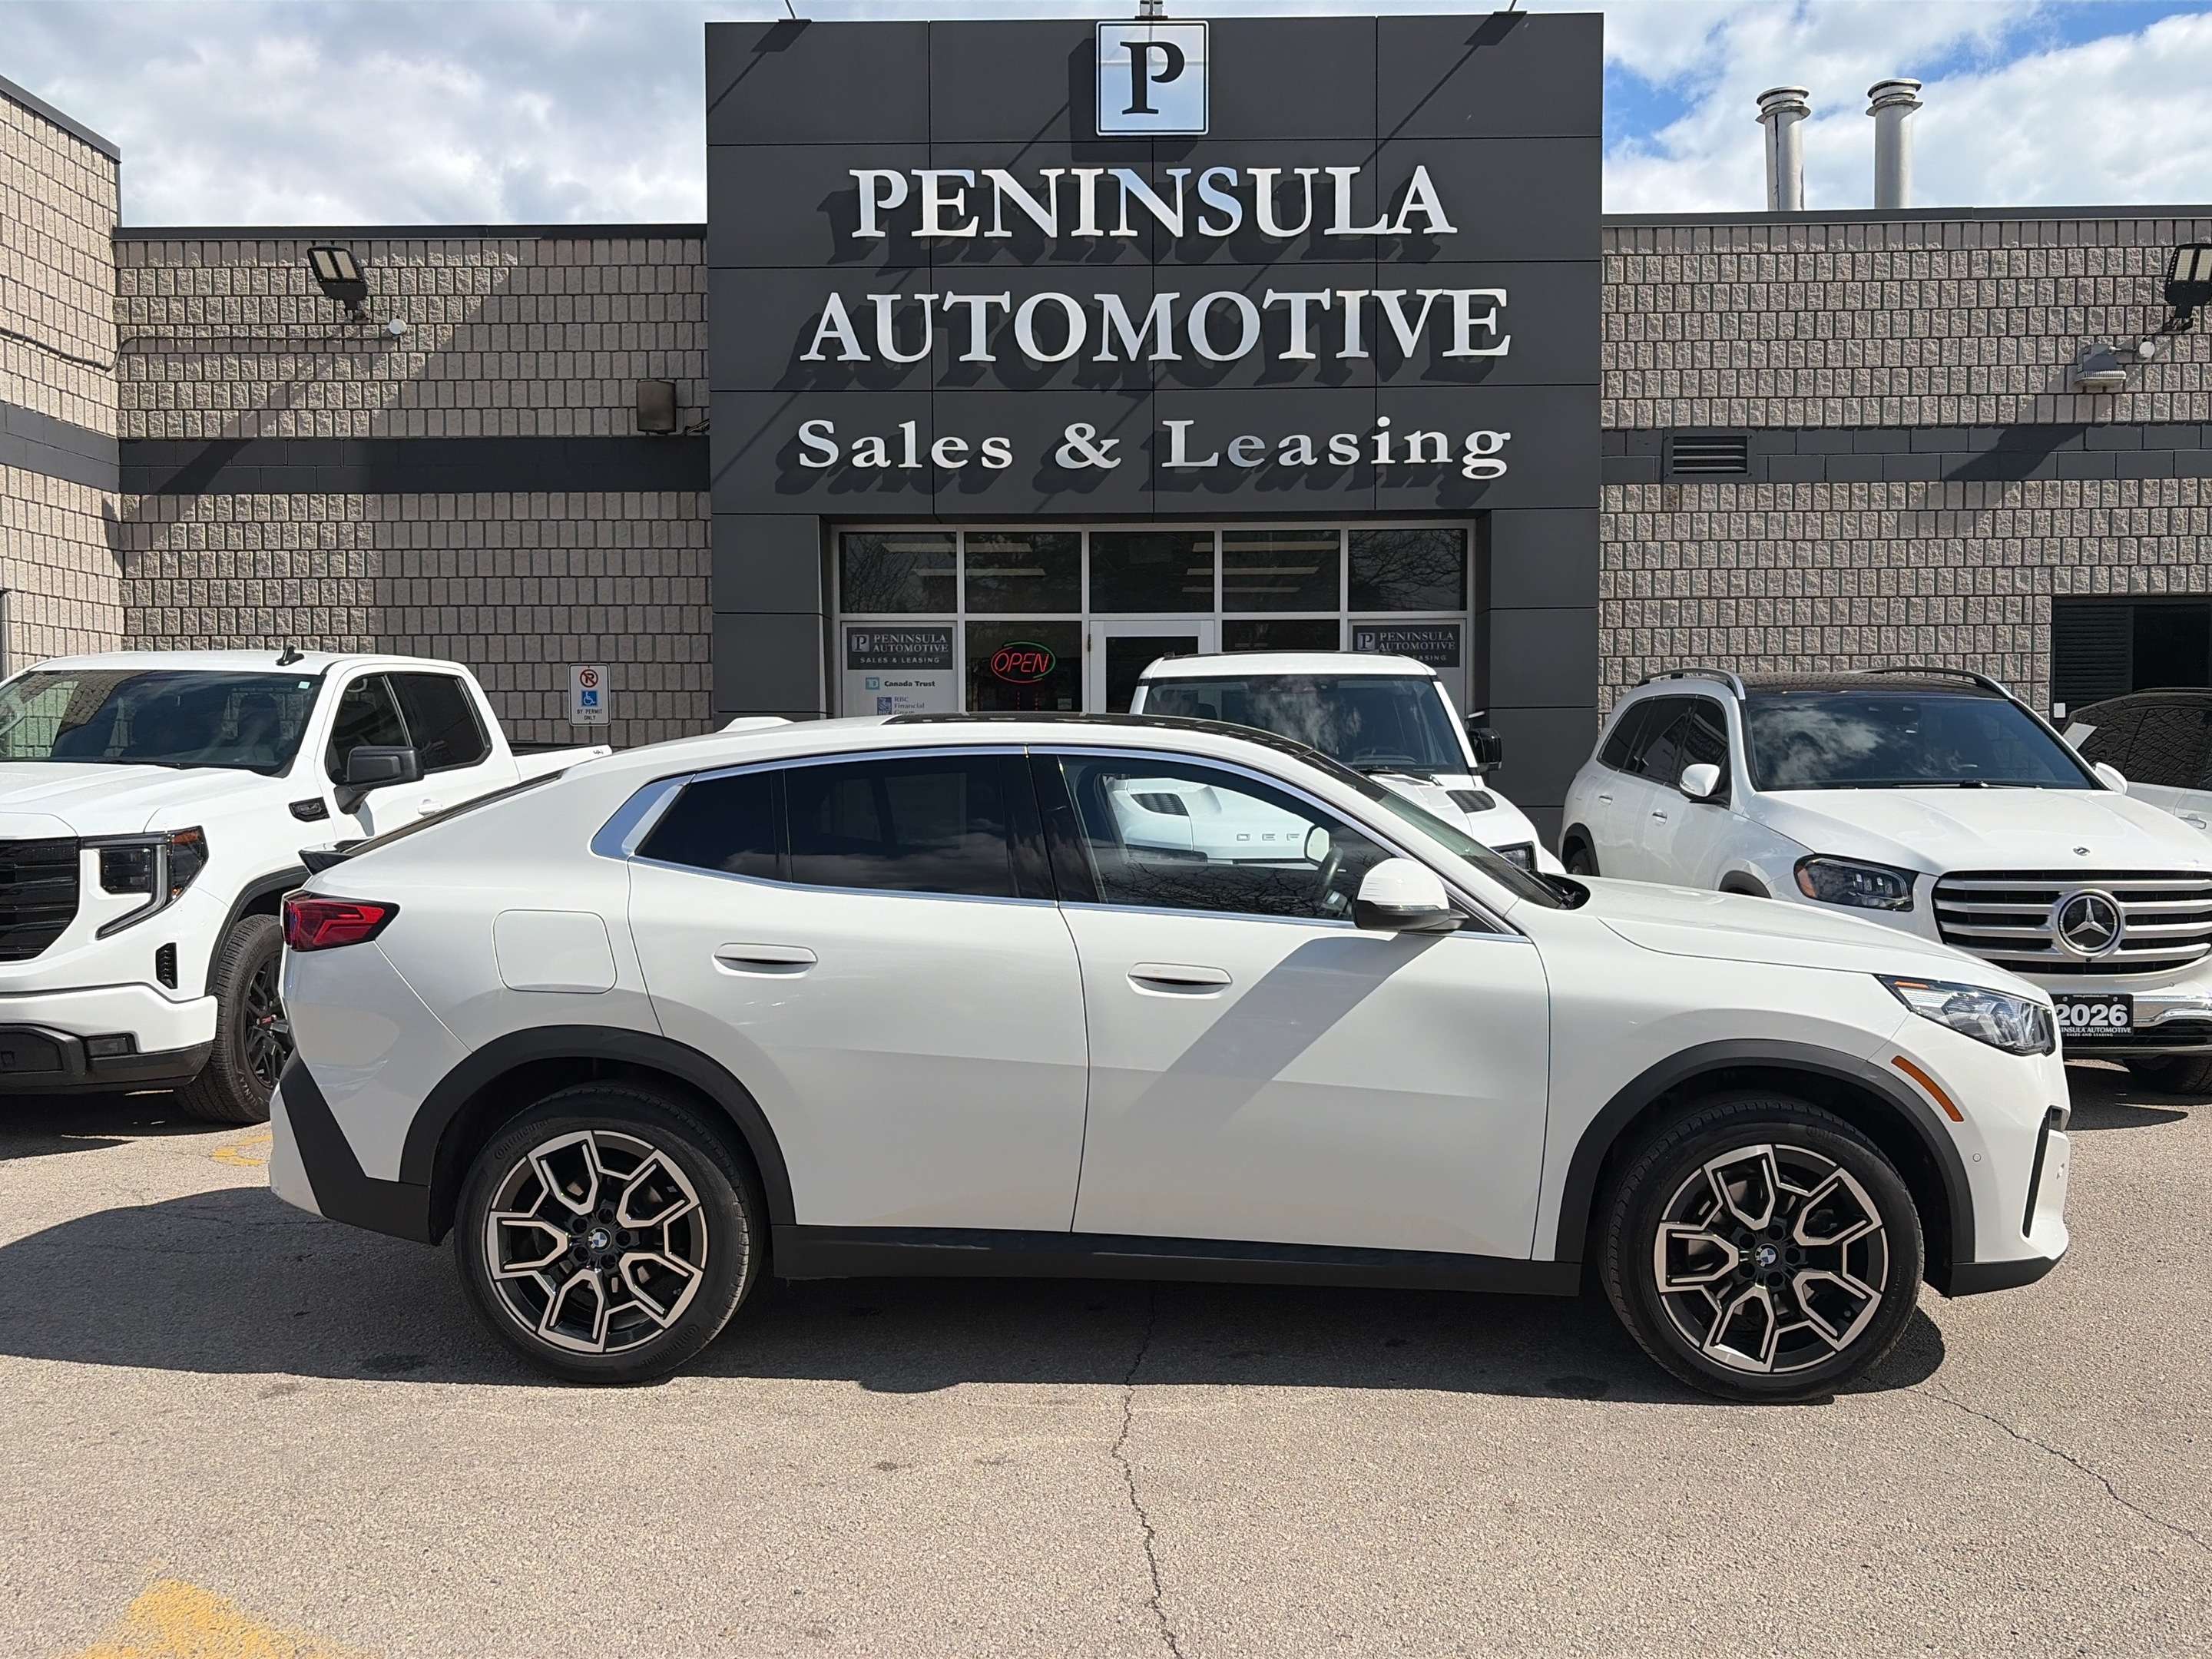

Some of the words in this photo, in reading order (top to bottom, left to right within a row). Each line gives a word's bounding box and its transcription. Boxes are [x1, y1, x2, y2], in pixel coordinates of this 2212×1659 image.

[1119, 41, 1186, 116] P
[848, 164, 1459, 238] PENINSULA
[799, 287, 1512, 363] AUTOMOTIVE
[797, 419, 1014, 469] Sales
[1054, 422, 1122, 469] &
[1161, 416, 1512, 480] Leasing
[873, 634, 947, 644] PENINSULA
[1379, 632, 1455, 641] PENINSULA
[1379, 641, 1456, 651] AUTOMOTIVE
[873, 644, 949, 653] AUTOMOTIVE
[994, 652, 1050, 673] OPEN
[2054, 1003, 2128, 1027] 2026
